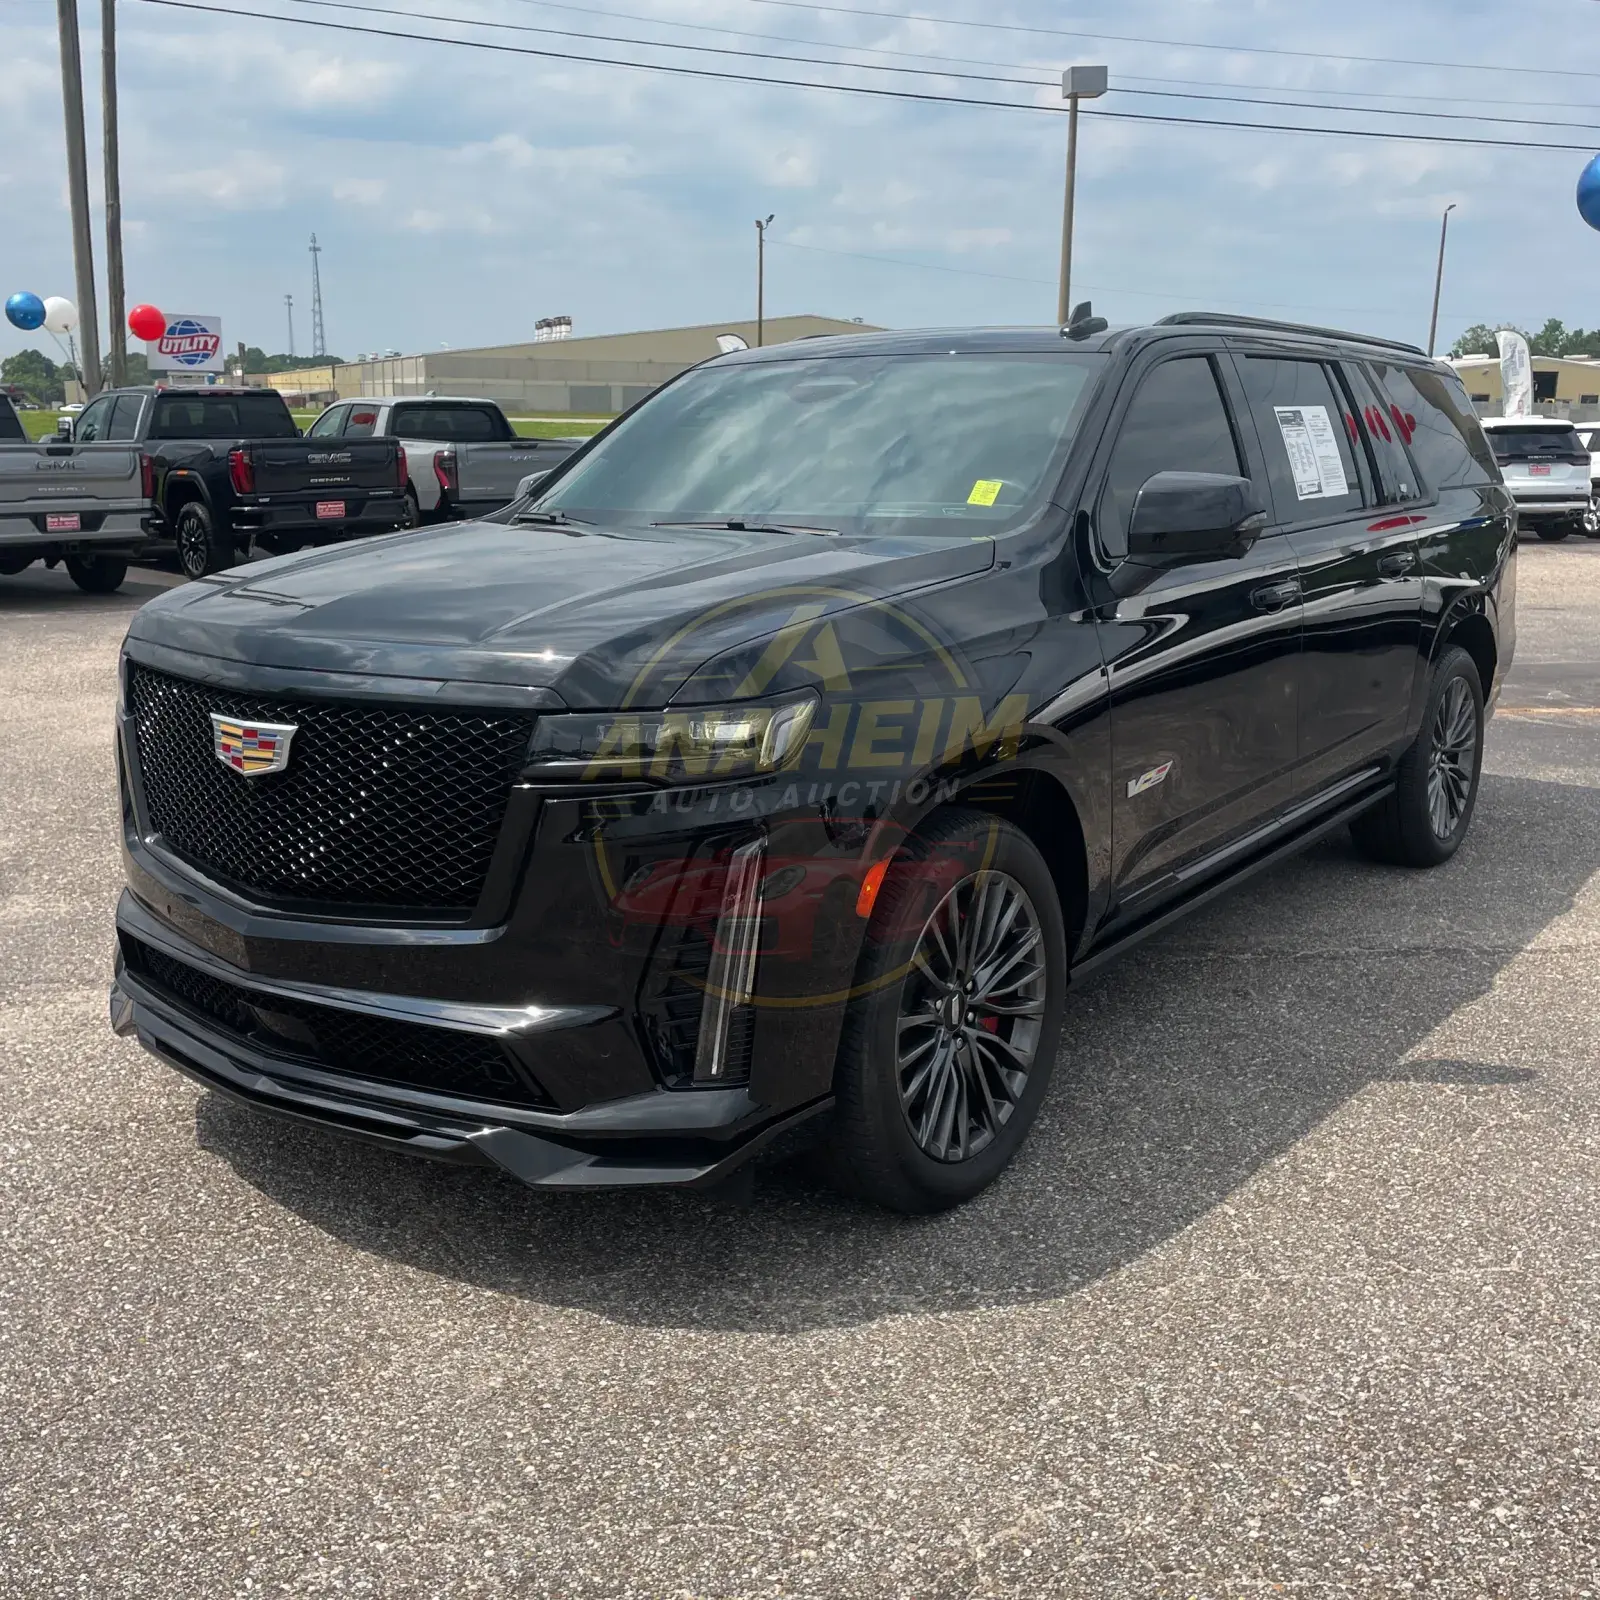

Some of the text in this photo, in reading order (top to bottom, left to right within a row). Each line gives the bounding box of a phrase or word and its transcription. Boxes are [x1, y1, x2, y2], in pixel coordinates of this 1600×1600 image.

[161, 336, 217, 353] UTILITY
[307, 453, 351, 463] GMC
[36, 460, 87, 471] GMC
[310, 476, 350, 484] DENALI
